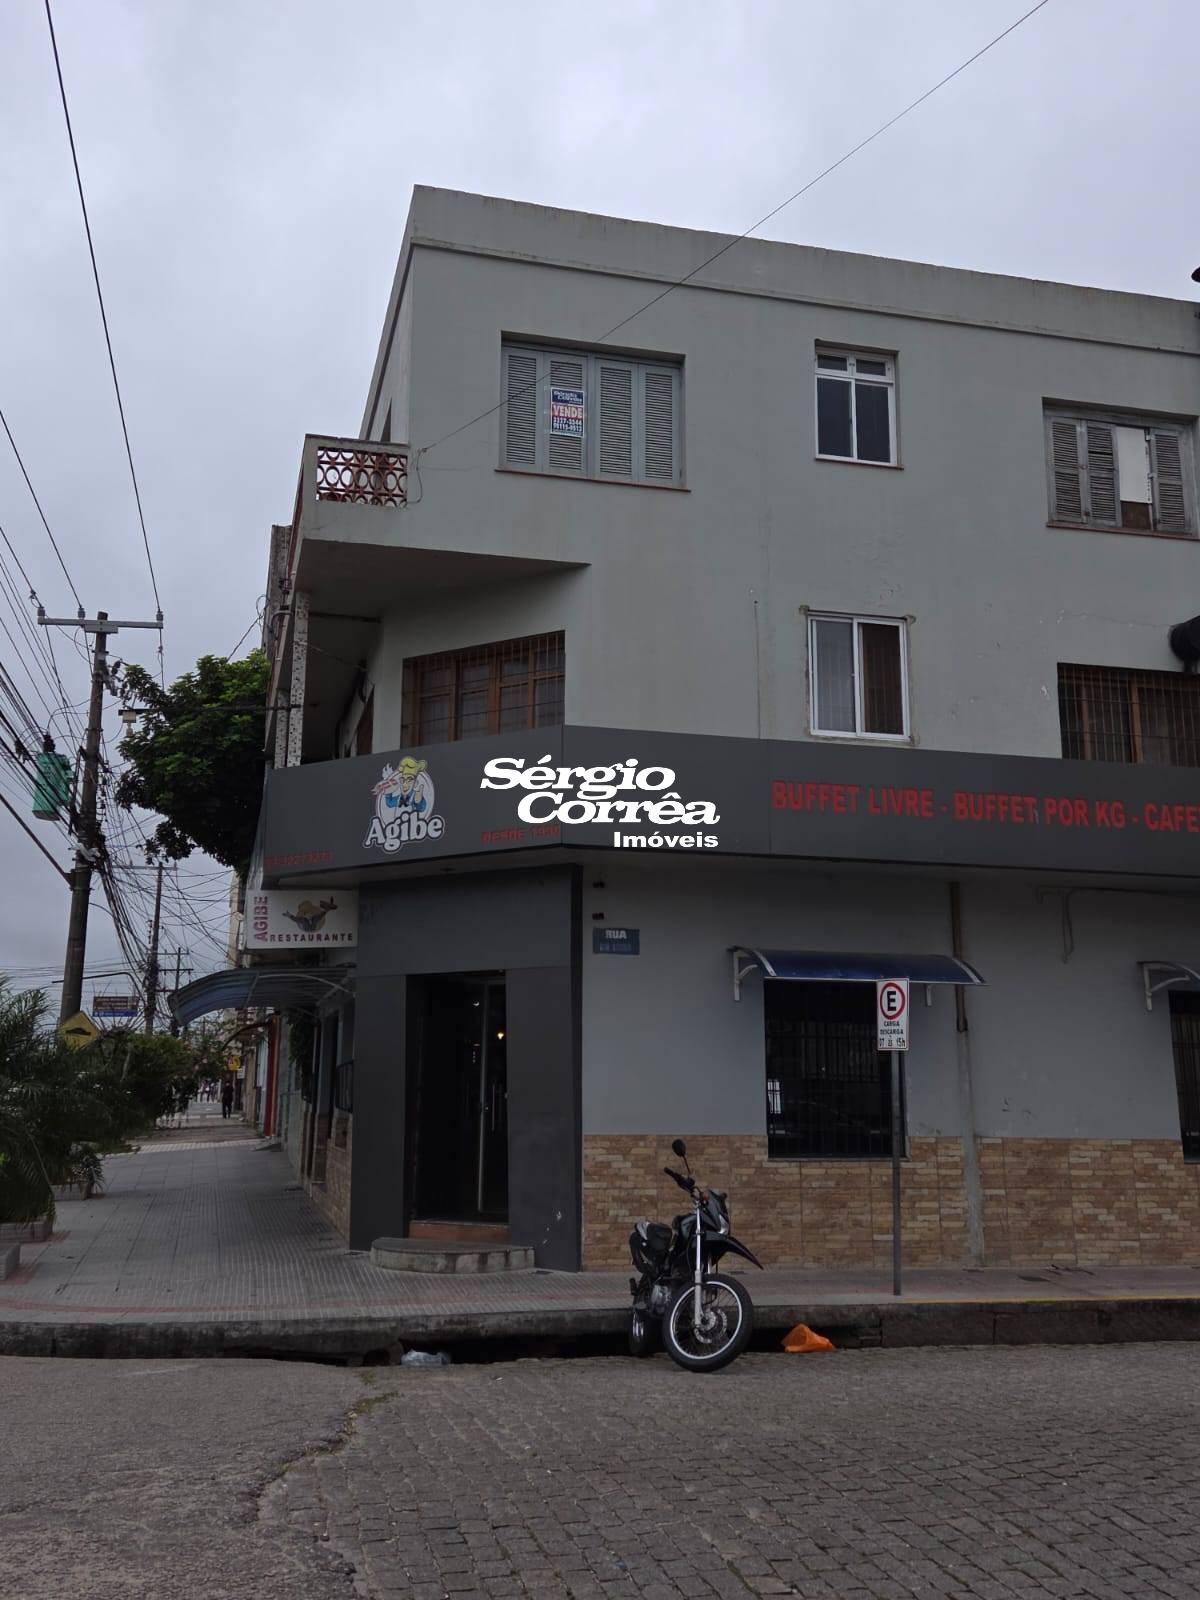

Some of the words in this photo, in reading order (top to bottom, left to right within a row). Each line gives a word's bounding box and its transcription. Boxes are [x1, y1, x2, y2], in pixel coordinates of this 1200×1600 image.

[553, 405, 582, 418] VENDE
[771, 780, 861, 815] BUFFET
[867, 784, 935, 818] LIVRE
[954, 791, 1039, 824] BUFFET
[1045, 797, 1089, 827] POR
[1096, 800, 1126, 829] KG
[364, 811, 443, 852] Agibe
[254, 896, 268, 942] AGIBE
[270, 933, 353, 942] RESTAURANTE
[605, 930, 627, 939] RUA
[887, 991, 896, 1011] E
